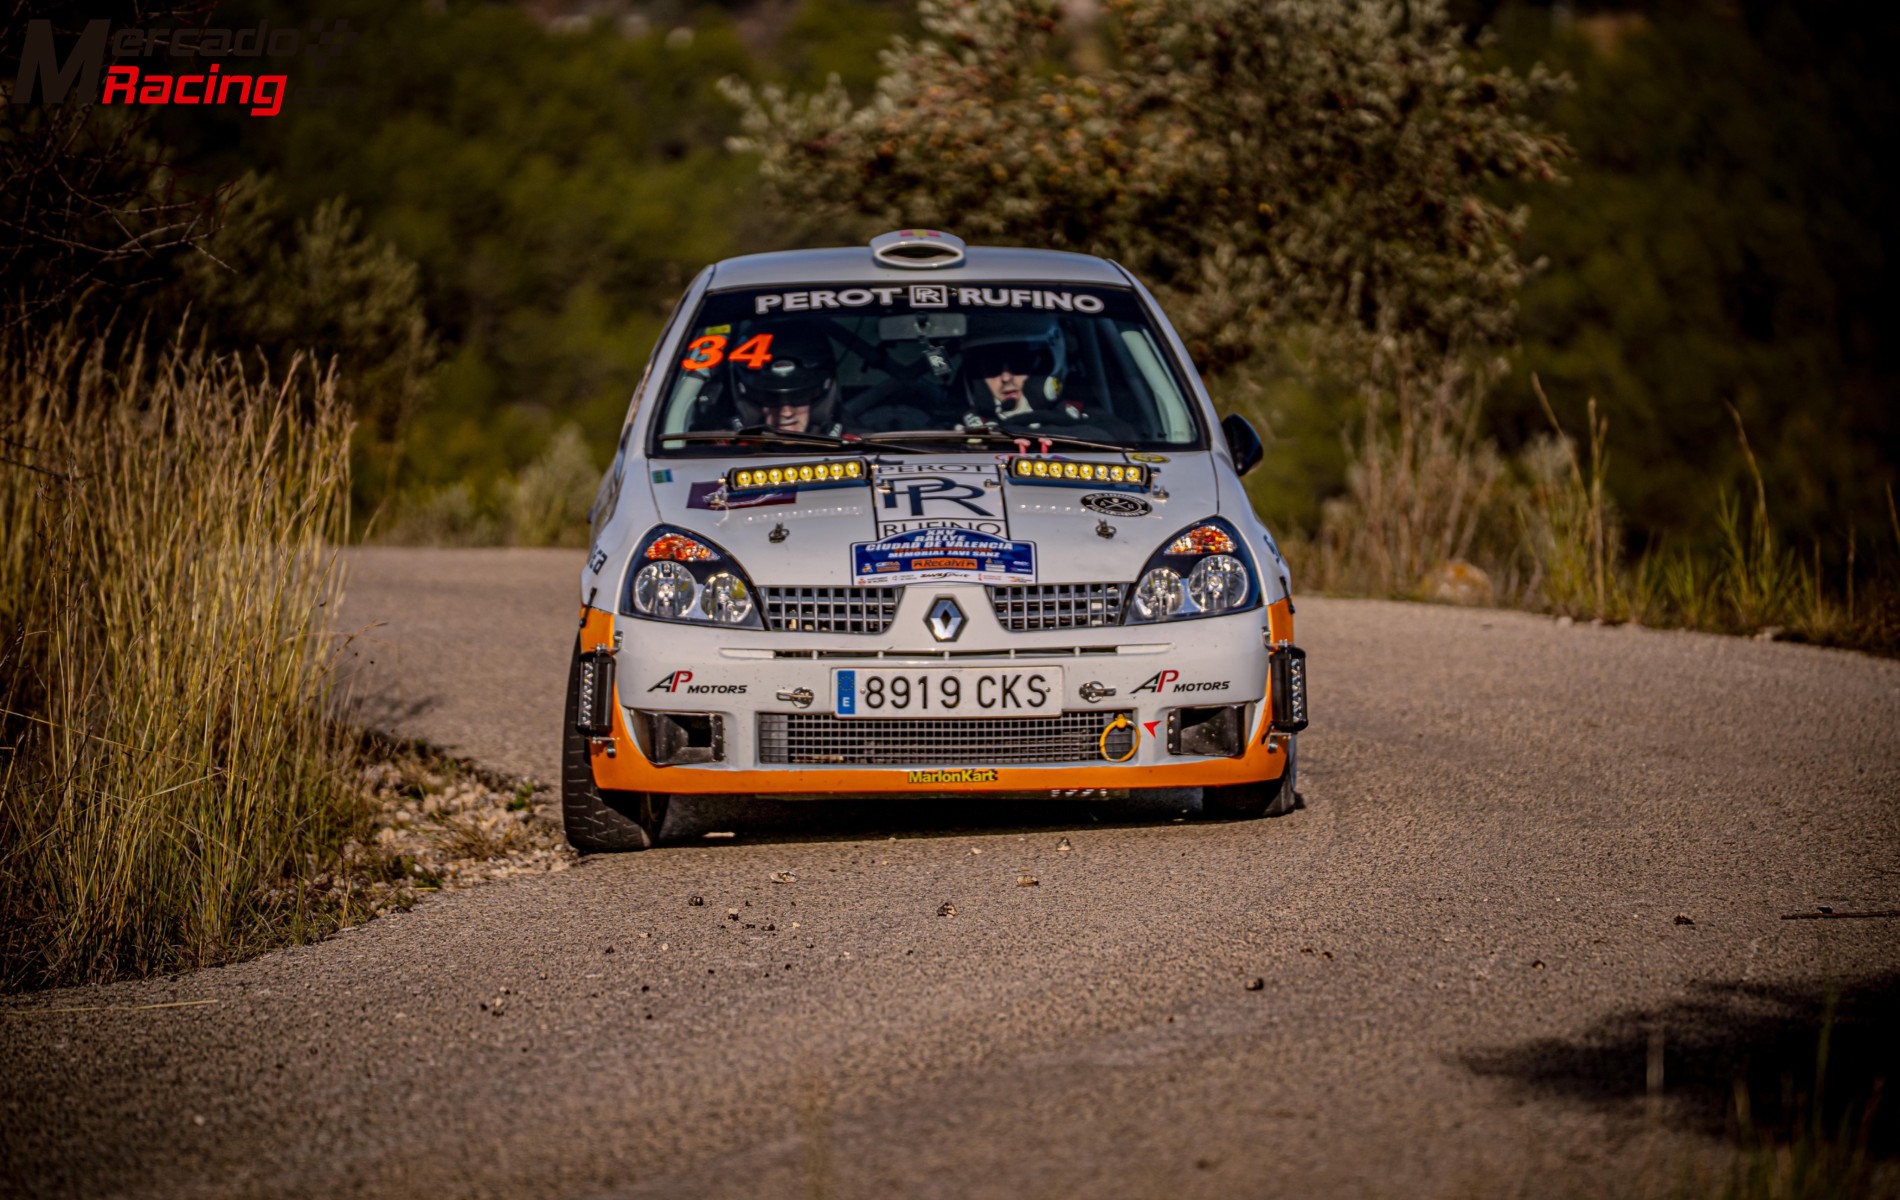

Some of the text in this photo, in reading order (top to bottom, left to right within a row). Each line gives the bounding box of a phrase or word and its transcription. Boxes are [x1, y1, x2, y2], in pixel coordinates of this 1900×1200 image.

[755, 288, 902, 314] PEROT
[958, 288, 1105, 313] RUFINO
[681, 333, 774, 371] 34
[878, 464, 991, 473] PEROT
[865, 541, 920, 551] CIUDAD
[945, 541, 1013, 550] VALENCIA
[647, 670, 747, 694] AP MOTORS
[865, 674, 1047, 709] 8919 CKS
[1130, 670, 1230, 693] AP MOTORS
[842, 697, 850, 707] E
[908, 769, 998, 783] MarlonKart
